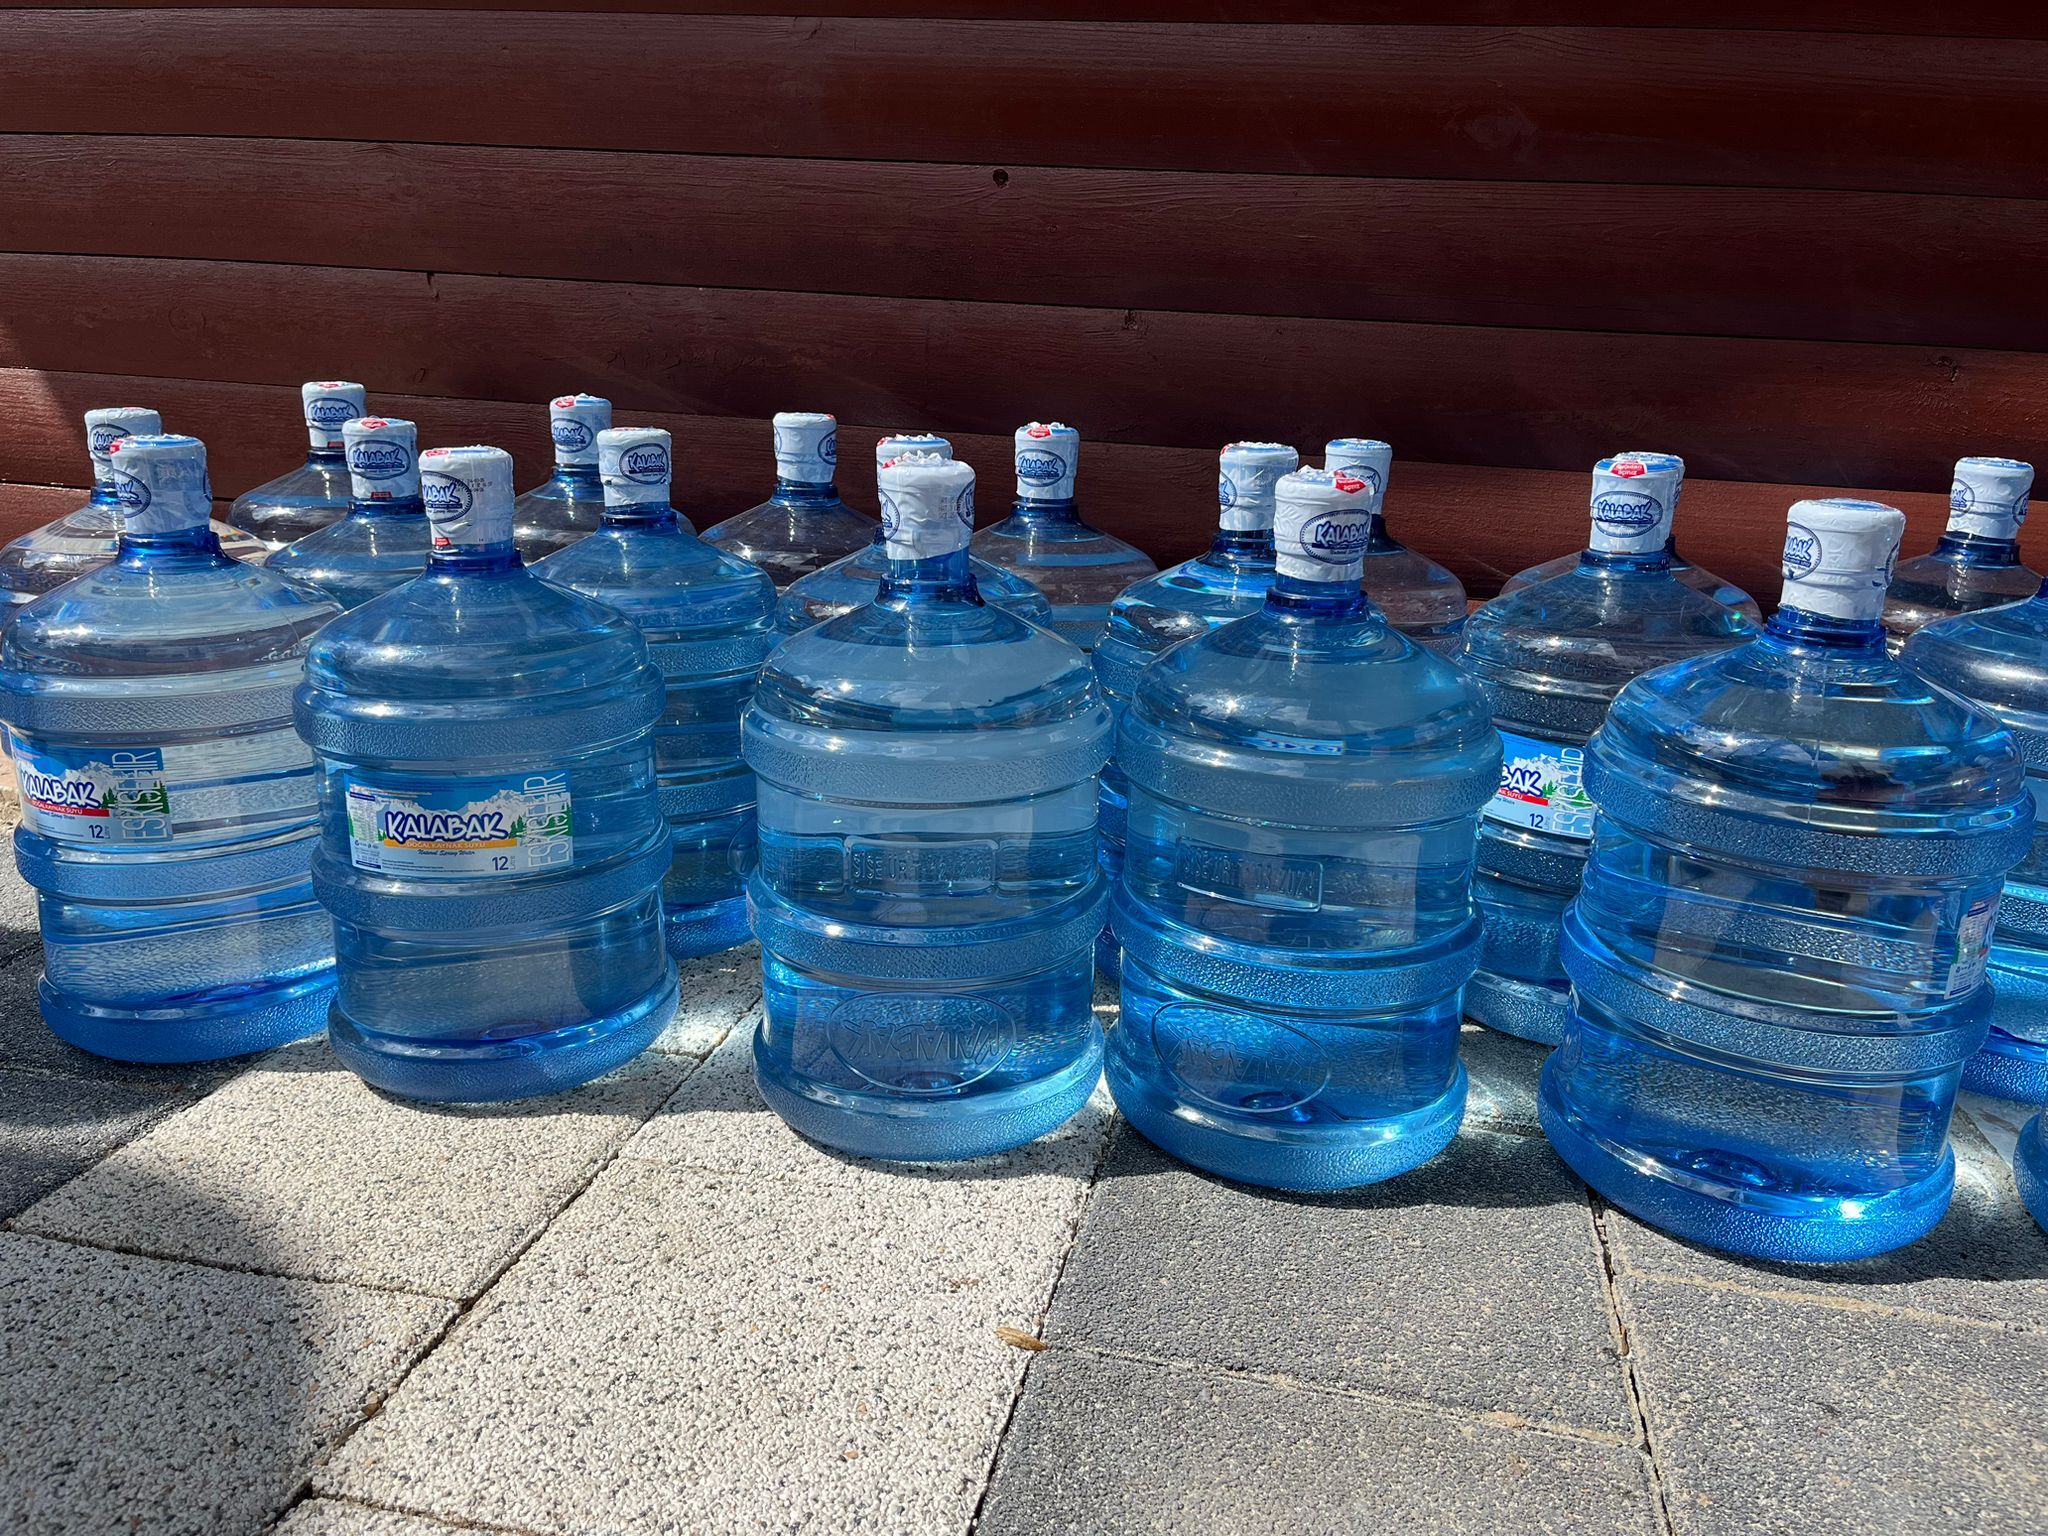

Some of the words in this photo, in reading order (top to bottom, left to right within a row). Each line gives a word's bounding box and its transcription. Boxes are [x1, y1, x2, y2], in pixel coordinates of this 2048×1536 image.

[353, 447, 403, 466] KALABAK
[1597, 500, 1653, 521] KALABAK
[21, 772, 99, 808] KALABAK
[386, 811, 509, 843] KALABAK
[1529, 814, 1544, 828] 12
[88, 825, 104, 839] 12
[492, 857, 509, 872] 12
